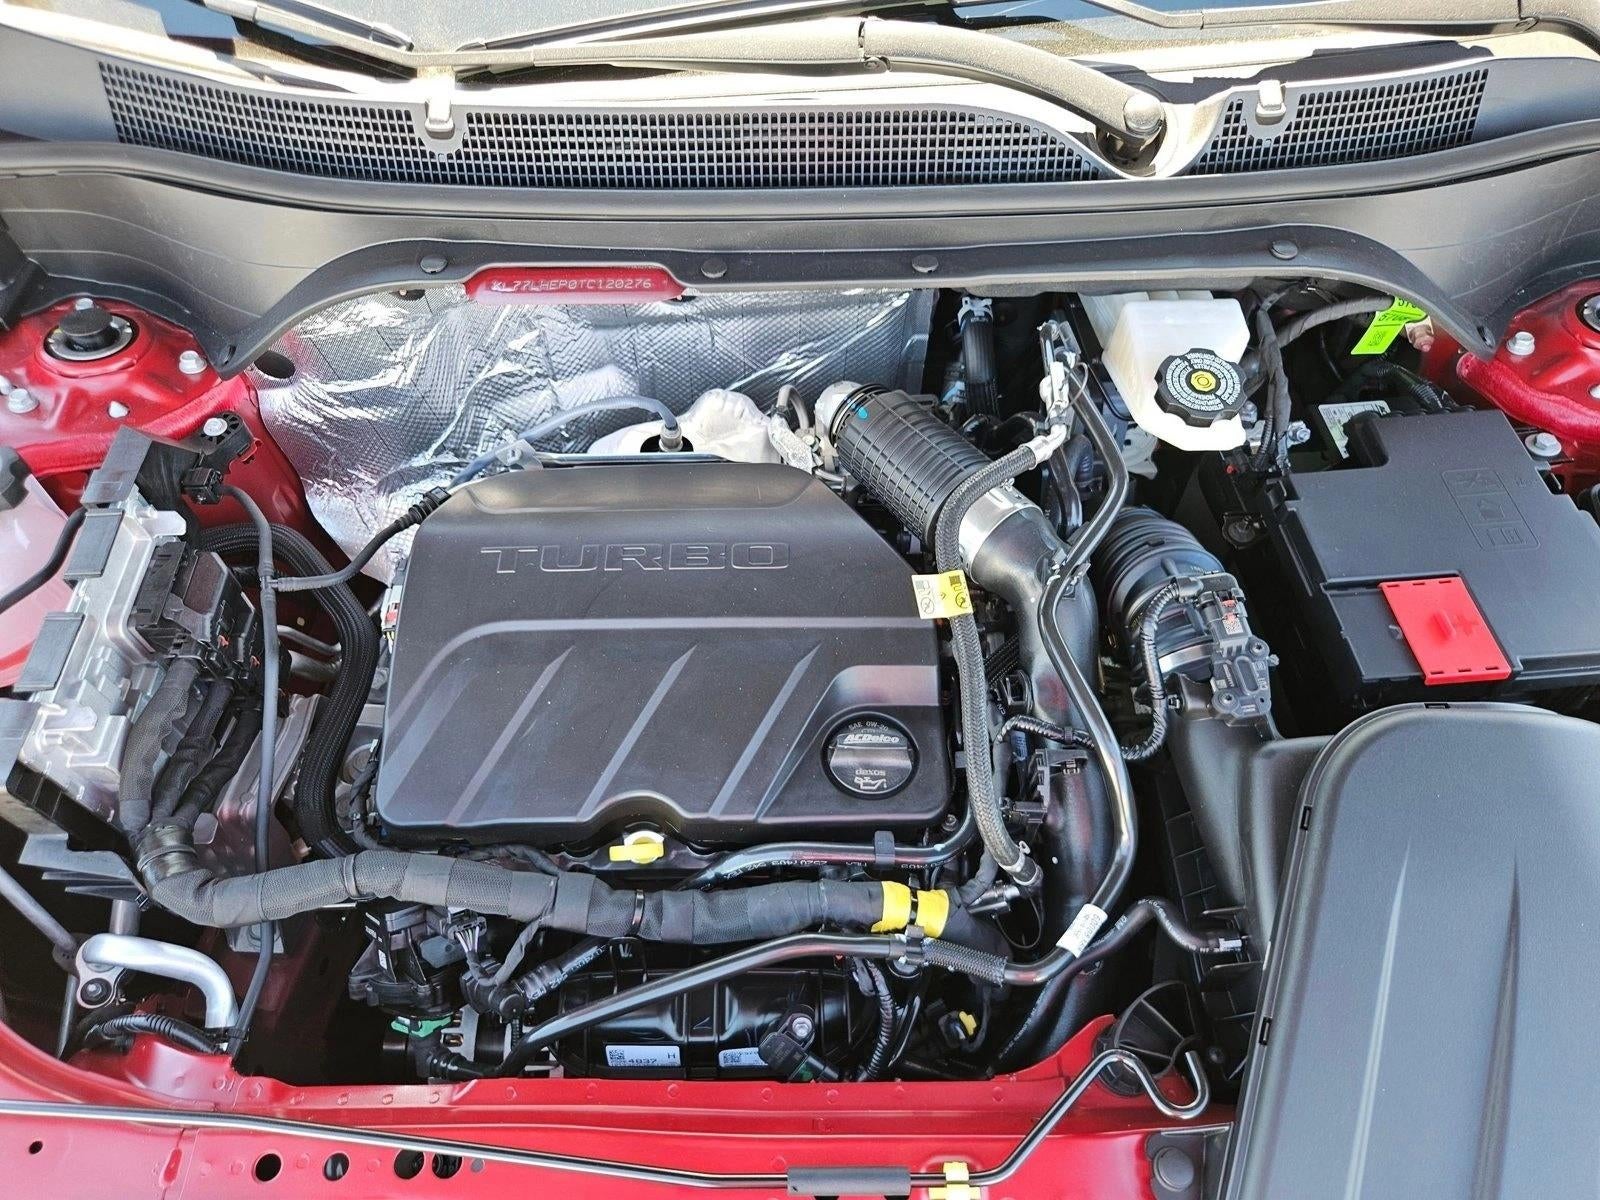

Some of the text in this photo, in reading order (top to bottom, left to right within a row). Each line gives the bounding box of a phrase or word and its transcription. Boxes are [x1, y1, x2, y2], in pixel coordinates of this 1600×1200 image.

[480, 542, 791, 574] TURBO
[849, 721, 889, 731] SAE 0W-20
[843, 734, 900, 744] ACDelco
[855, 768, 886, 777] dexos
